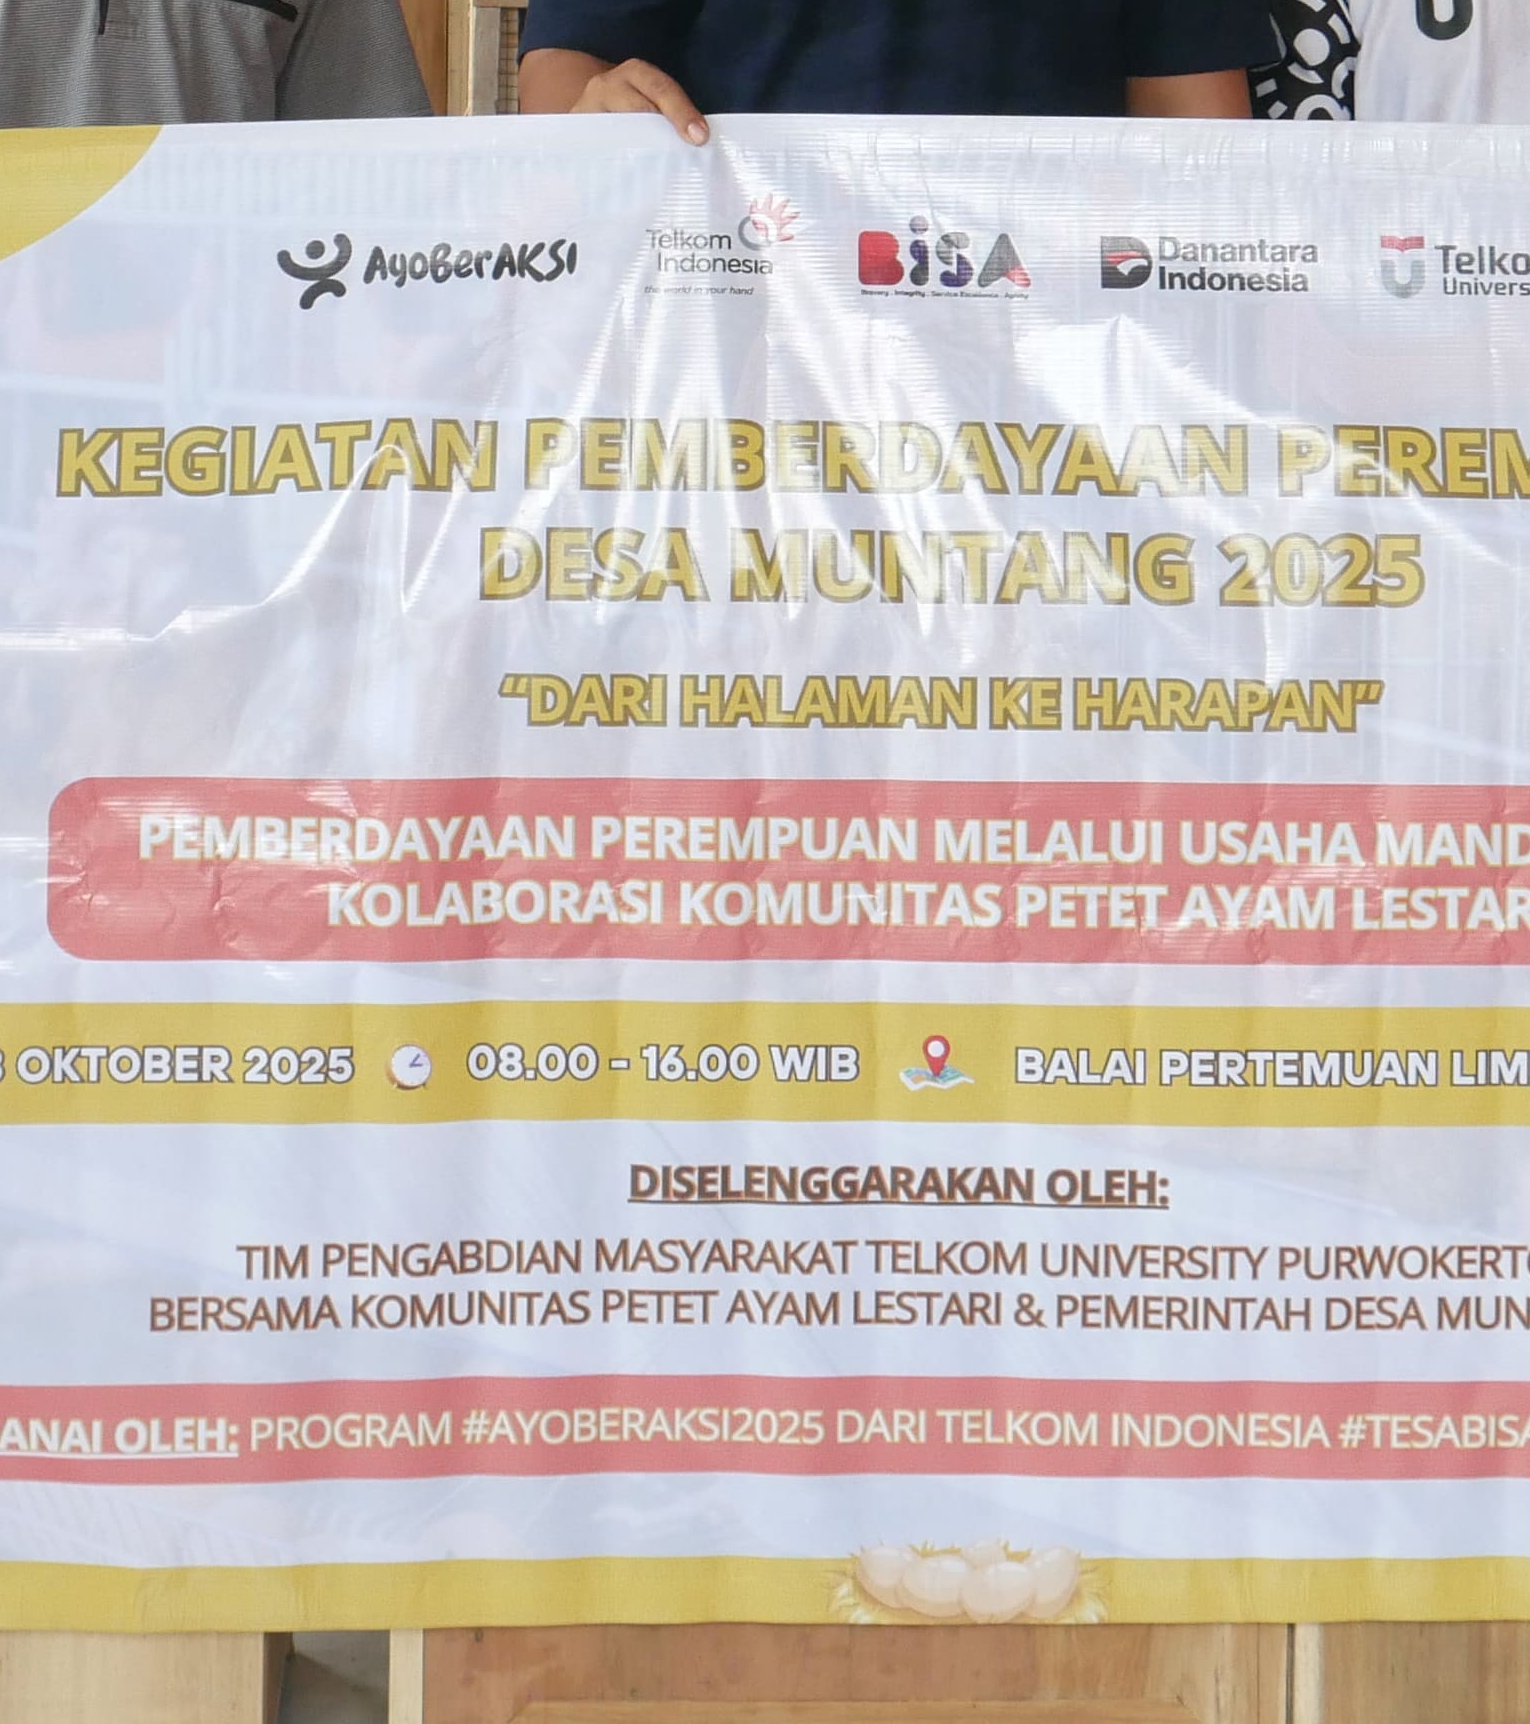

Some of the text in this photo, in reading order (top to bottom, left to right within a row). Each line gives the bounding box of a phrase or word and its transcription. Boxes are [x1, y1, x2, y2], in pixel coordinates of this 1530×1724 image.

[646, 228, 732, 250] Telkom
[1158, 236, 1319, 265] Danantara
[364, 240, 578, 288] AyoBerAKSI
[658, 252, 773, 275] Indonesia
[1158, 265, 1310, 294] Indonesia
[729, 286, 754, 296] hand
[56, 418, 498, 498] KEGIATAN
[525, 417, 1248, 495] PEMBERDAYAAN
[480, 527, 1426, 608] DESA MUNTANG 2025
[680, 674, 977, 730] HALAMAN
[988, 678, 1064, 730] KE
[137, 813, 576, 862] PEMBERDAYAAN
[591, 813, 916, 862] PEREMPUAN
[933, 817, 1165, 866] MELALUI
[1178, 819, 1365, 867] USAHA
[326, 878, 665, 928] KOLABORASI
[677, 879, 1003, 930] KOMUNITAS
[1016, 884, 1169, 931] PETET
[1180, 885, 1336, 932] AYAM
[15, 1045, 236, 1084] OKTOBER
[243, 1043, 355, 1084] 2025
[466, 1042, 601, 1082] 08.00
[640, 1044, 760, 1082] 16.00
[769, 1043, 861, 1082] WIB
[1014, 1045, 1147, 1085] BALAI
[1159, 1048, 1440, 1088] PERTEMUAN
[628, 1164, 1171, 1209] DISELENGGARAKAN OLEH:
[236, 1243, 310, 1280] TIM
[322, 1238, 582, 1279] PENGABDIAN
[594, 1238, 859, 1275] MASYARAKAT
[865, 1239, 1028, 1277] TELKOM
[1040, 1242, 1270, 1280] UNIVERSITY
[149, 1295, 343, 1333] BERSAMA
[350, 1289, 591, 1331] KOMUNITAS
[602, 1289, 720, 1325] PETET
[725, 1289, 841, 1325] AYAM
[852, 1290, 1003, 1328] LESTARI
[1013, 1291, 1046, 1329] &
[1055, 1293, 1311, 1332] PEMERINTAH
[1324, 1295, 1429, 1332] DESA
[114, 1415, 240, 1457] OLEH:
[250, 1409, 453, 1452] PROGRAM
[460, 1407, 826, 1445] #AYOBERAKSI2025
[836, 1409, 927, 1444] DARI
[936, 1409, 1100, 1446] TELKOM
[1110, 1411, 1331, 1449] INDONESIA
